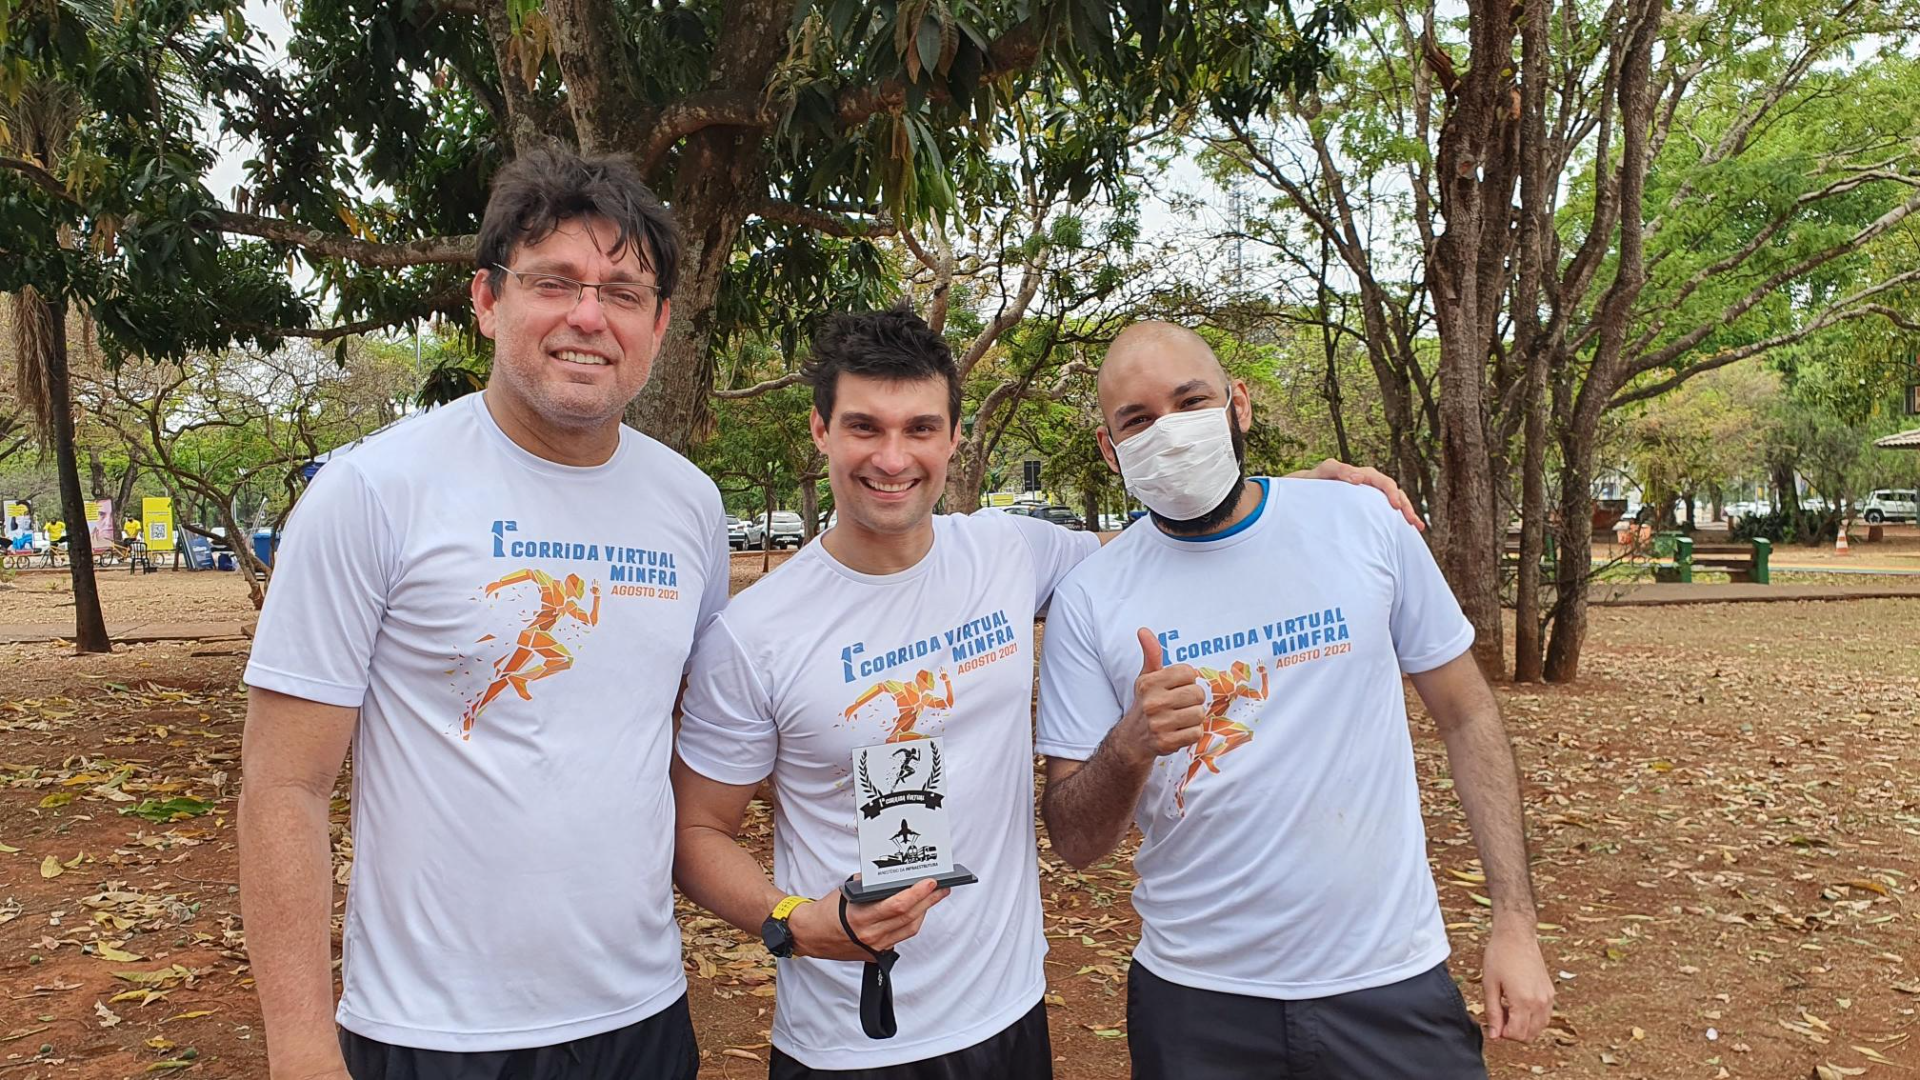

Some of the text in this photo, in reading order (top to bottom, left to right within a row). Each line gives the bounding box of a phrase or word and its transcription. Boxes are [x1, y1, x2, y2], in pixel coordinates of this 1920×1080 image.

[611, 585, 679, 600] AGOSTO 2021
[957, 642, 1018, 676] AGOSTO 2021
[1275, 642, 1352, 670] AGOSTO 2021
